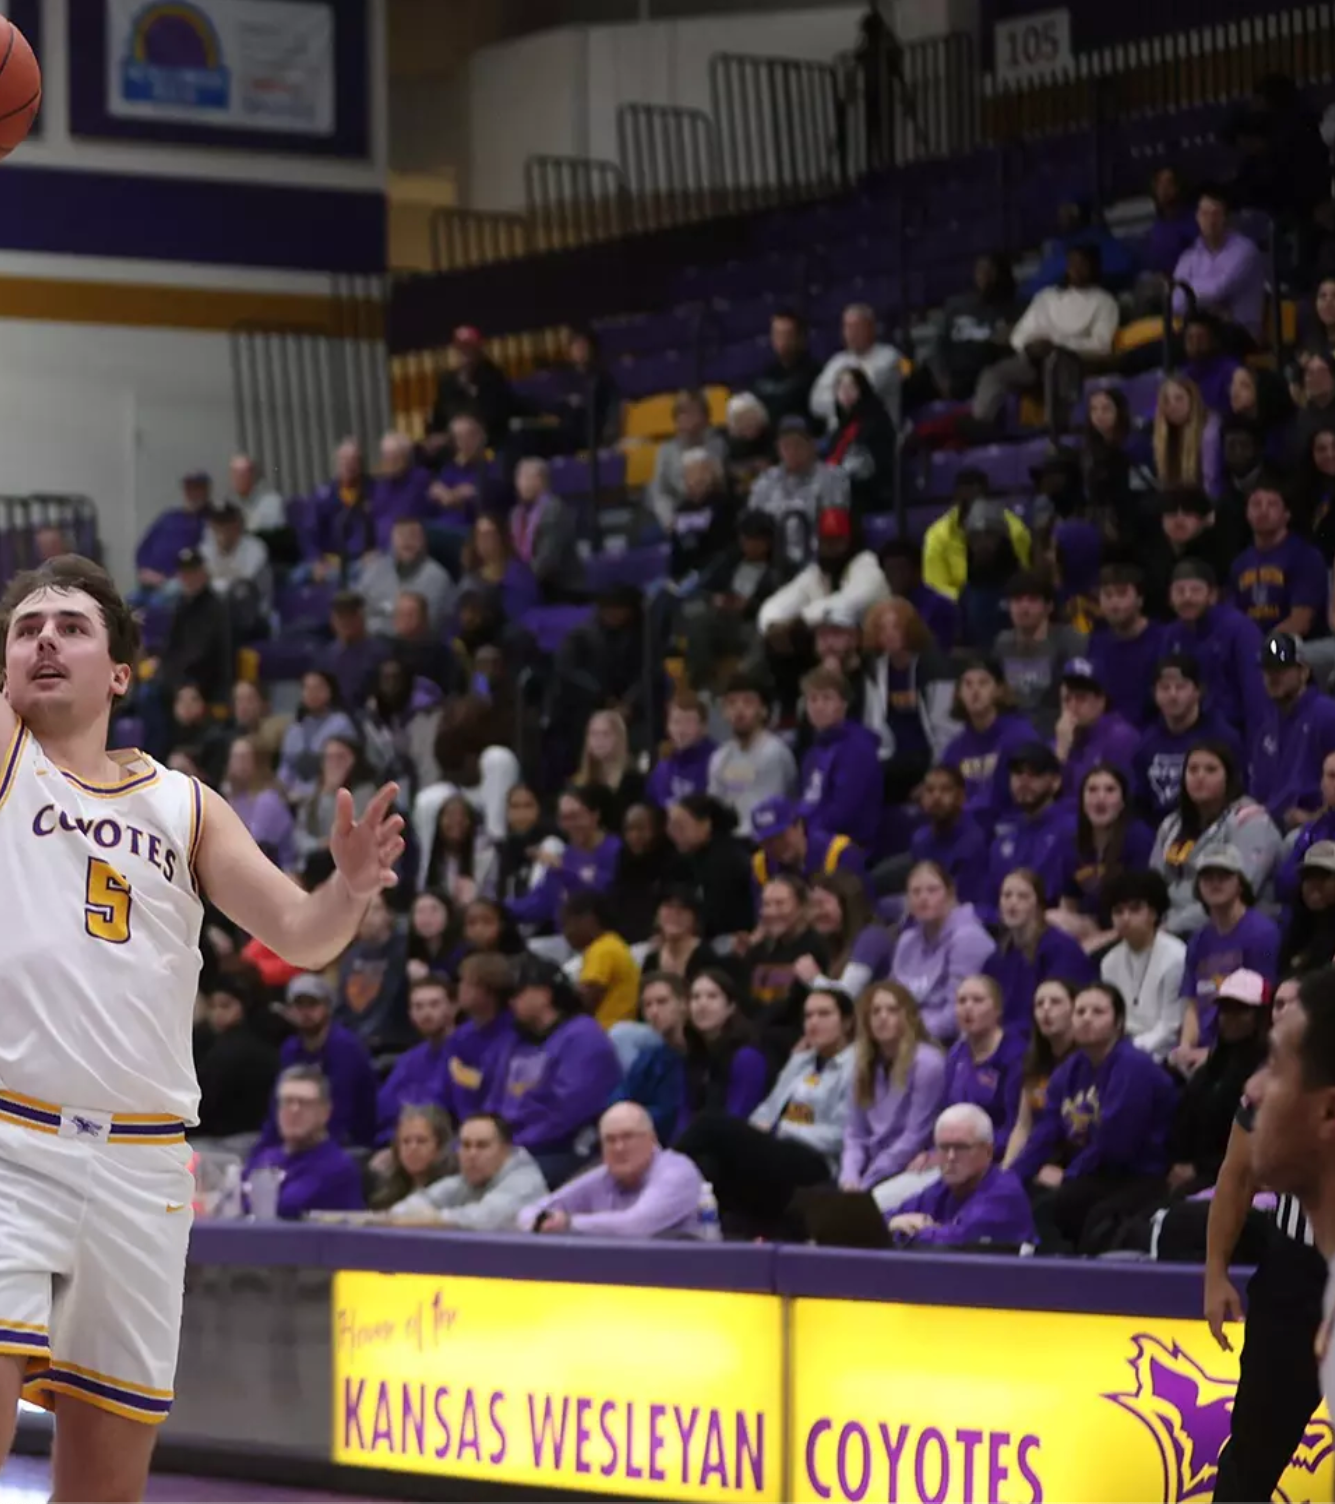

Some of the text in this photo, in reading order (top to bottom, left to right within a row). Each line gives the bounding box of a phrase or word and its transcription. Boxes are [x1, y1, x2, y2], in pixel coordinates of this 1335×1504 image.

[1006, 20, 1060, 69] 105
[85, 855, 133, 944] 5
[344, 1376, 765, 1491] KANSAS WESLEYAN
[805, 1416, 1044, 1504] COYOTES
